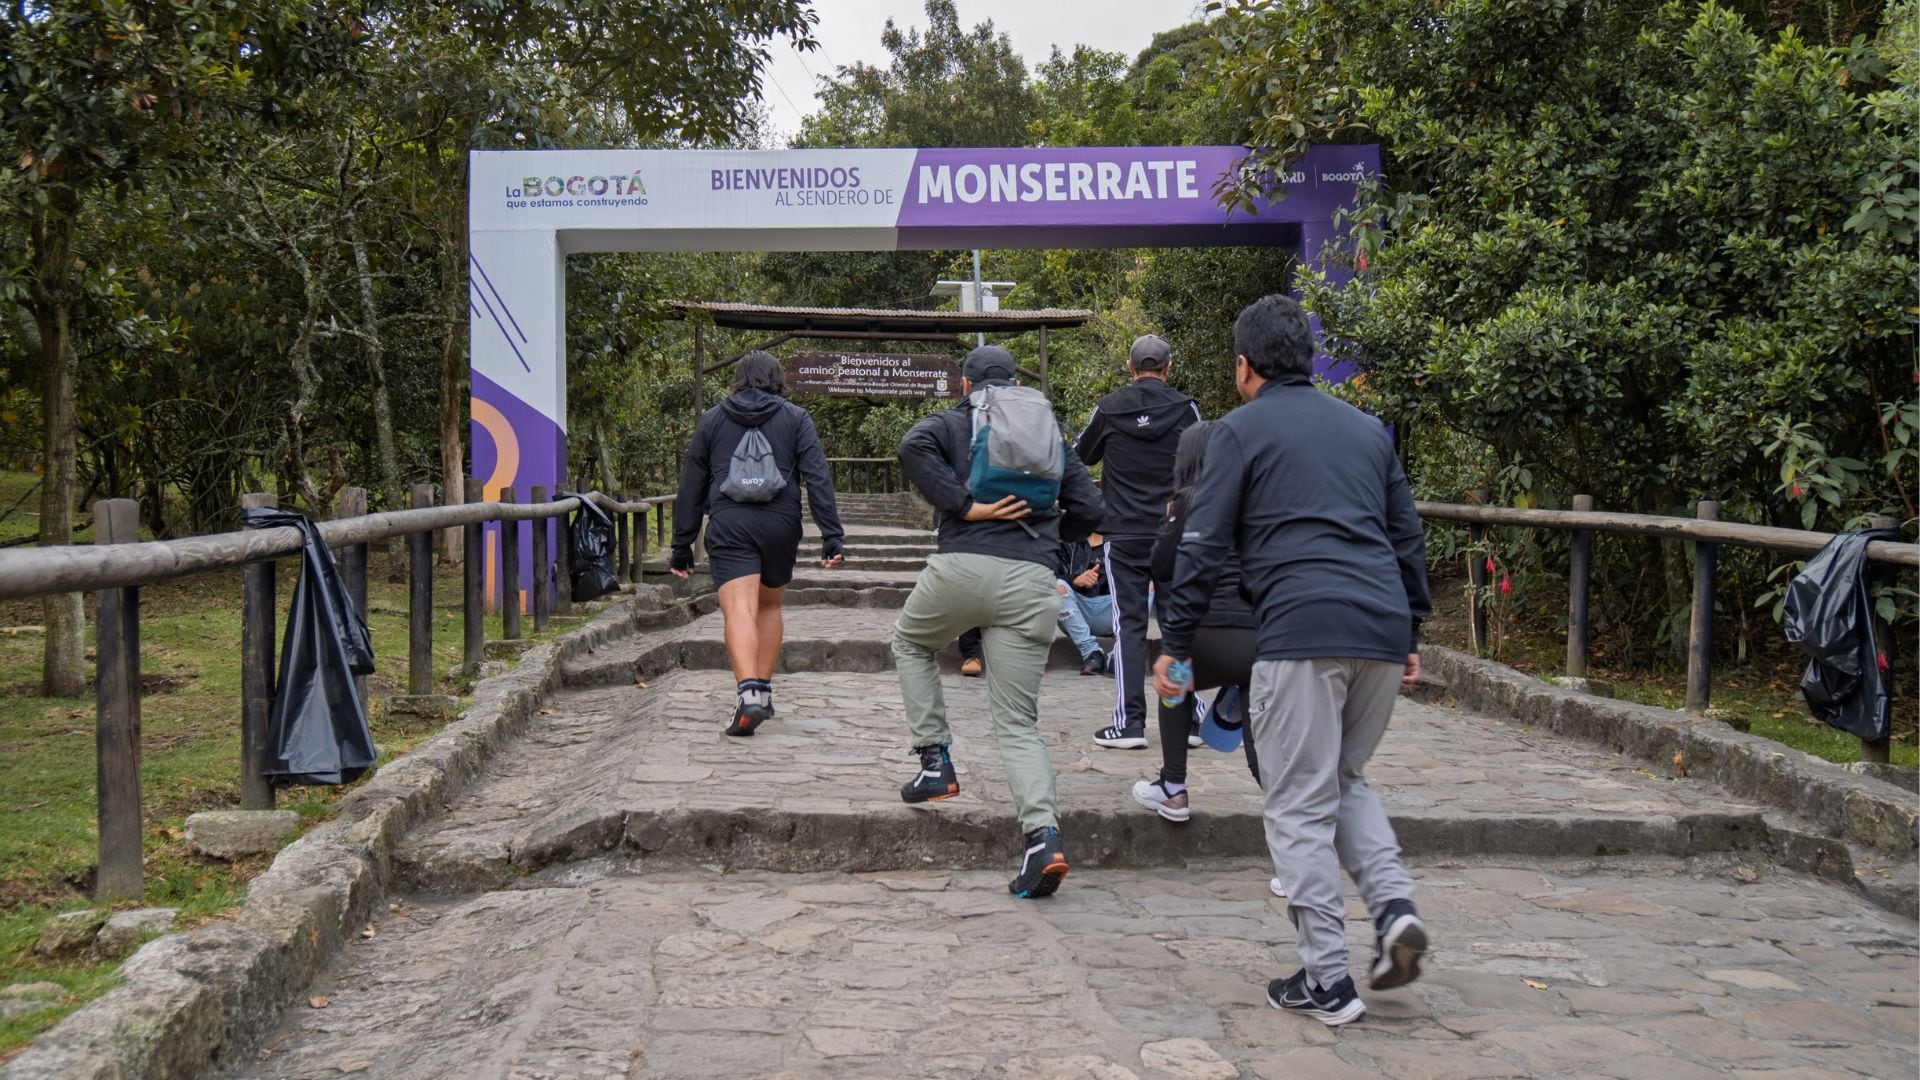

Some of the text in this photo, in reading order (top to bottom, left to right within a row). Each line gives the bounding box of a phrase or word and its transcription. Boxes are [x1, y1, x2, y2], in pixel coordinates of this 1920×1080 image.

[506, 169, 647, 198] La BOGOTÁ
[711, 166, 861, 191] BIENVENIDOS
[918, 160, 1199, 204] MONSERRATE
[506, 196, 649, 210] que estamos construyendo
[775, 188, 895, 207] AL SENDERO DE
[841, 355, 911, 367] Bienvenidos al
[798, 365, 948, 378] camino peatonal a Monserrate
[865, 387, 898, 395] Monserrate
[899, 388, 913, 396] path
